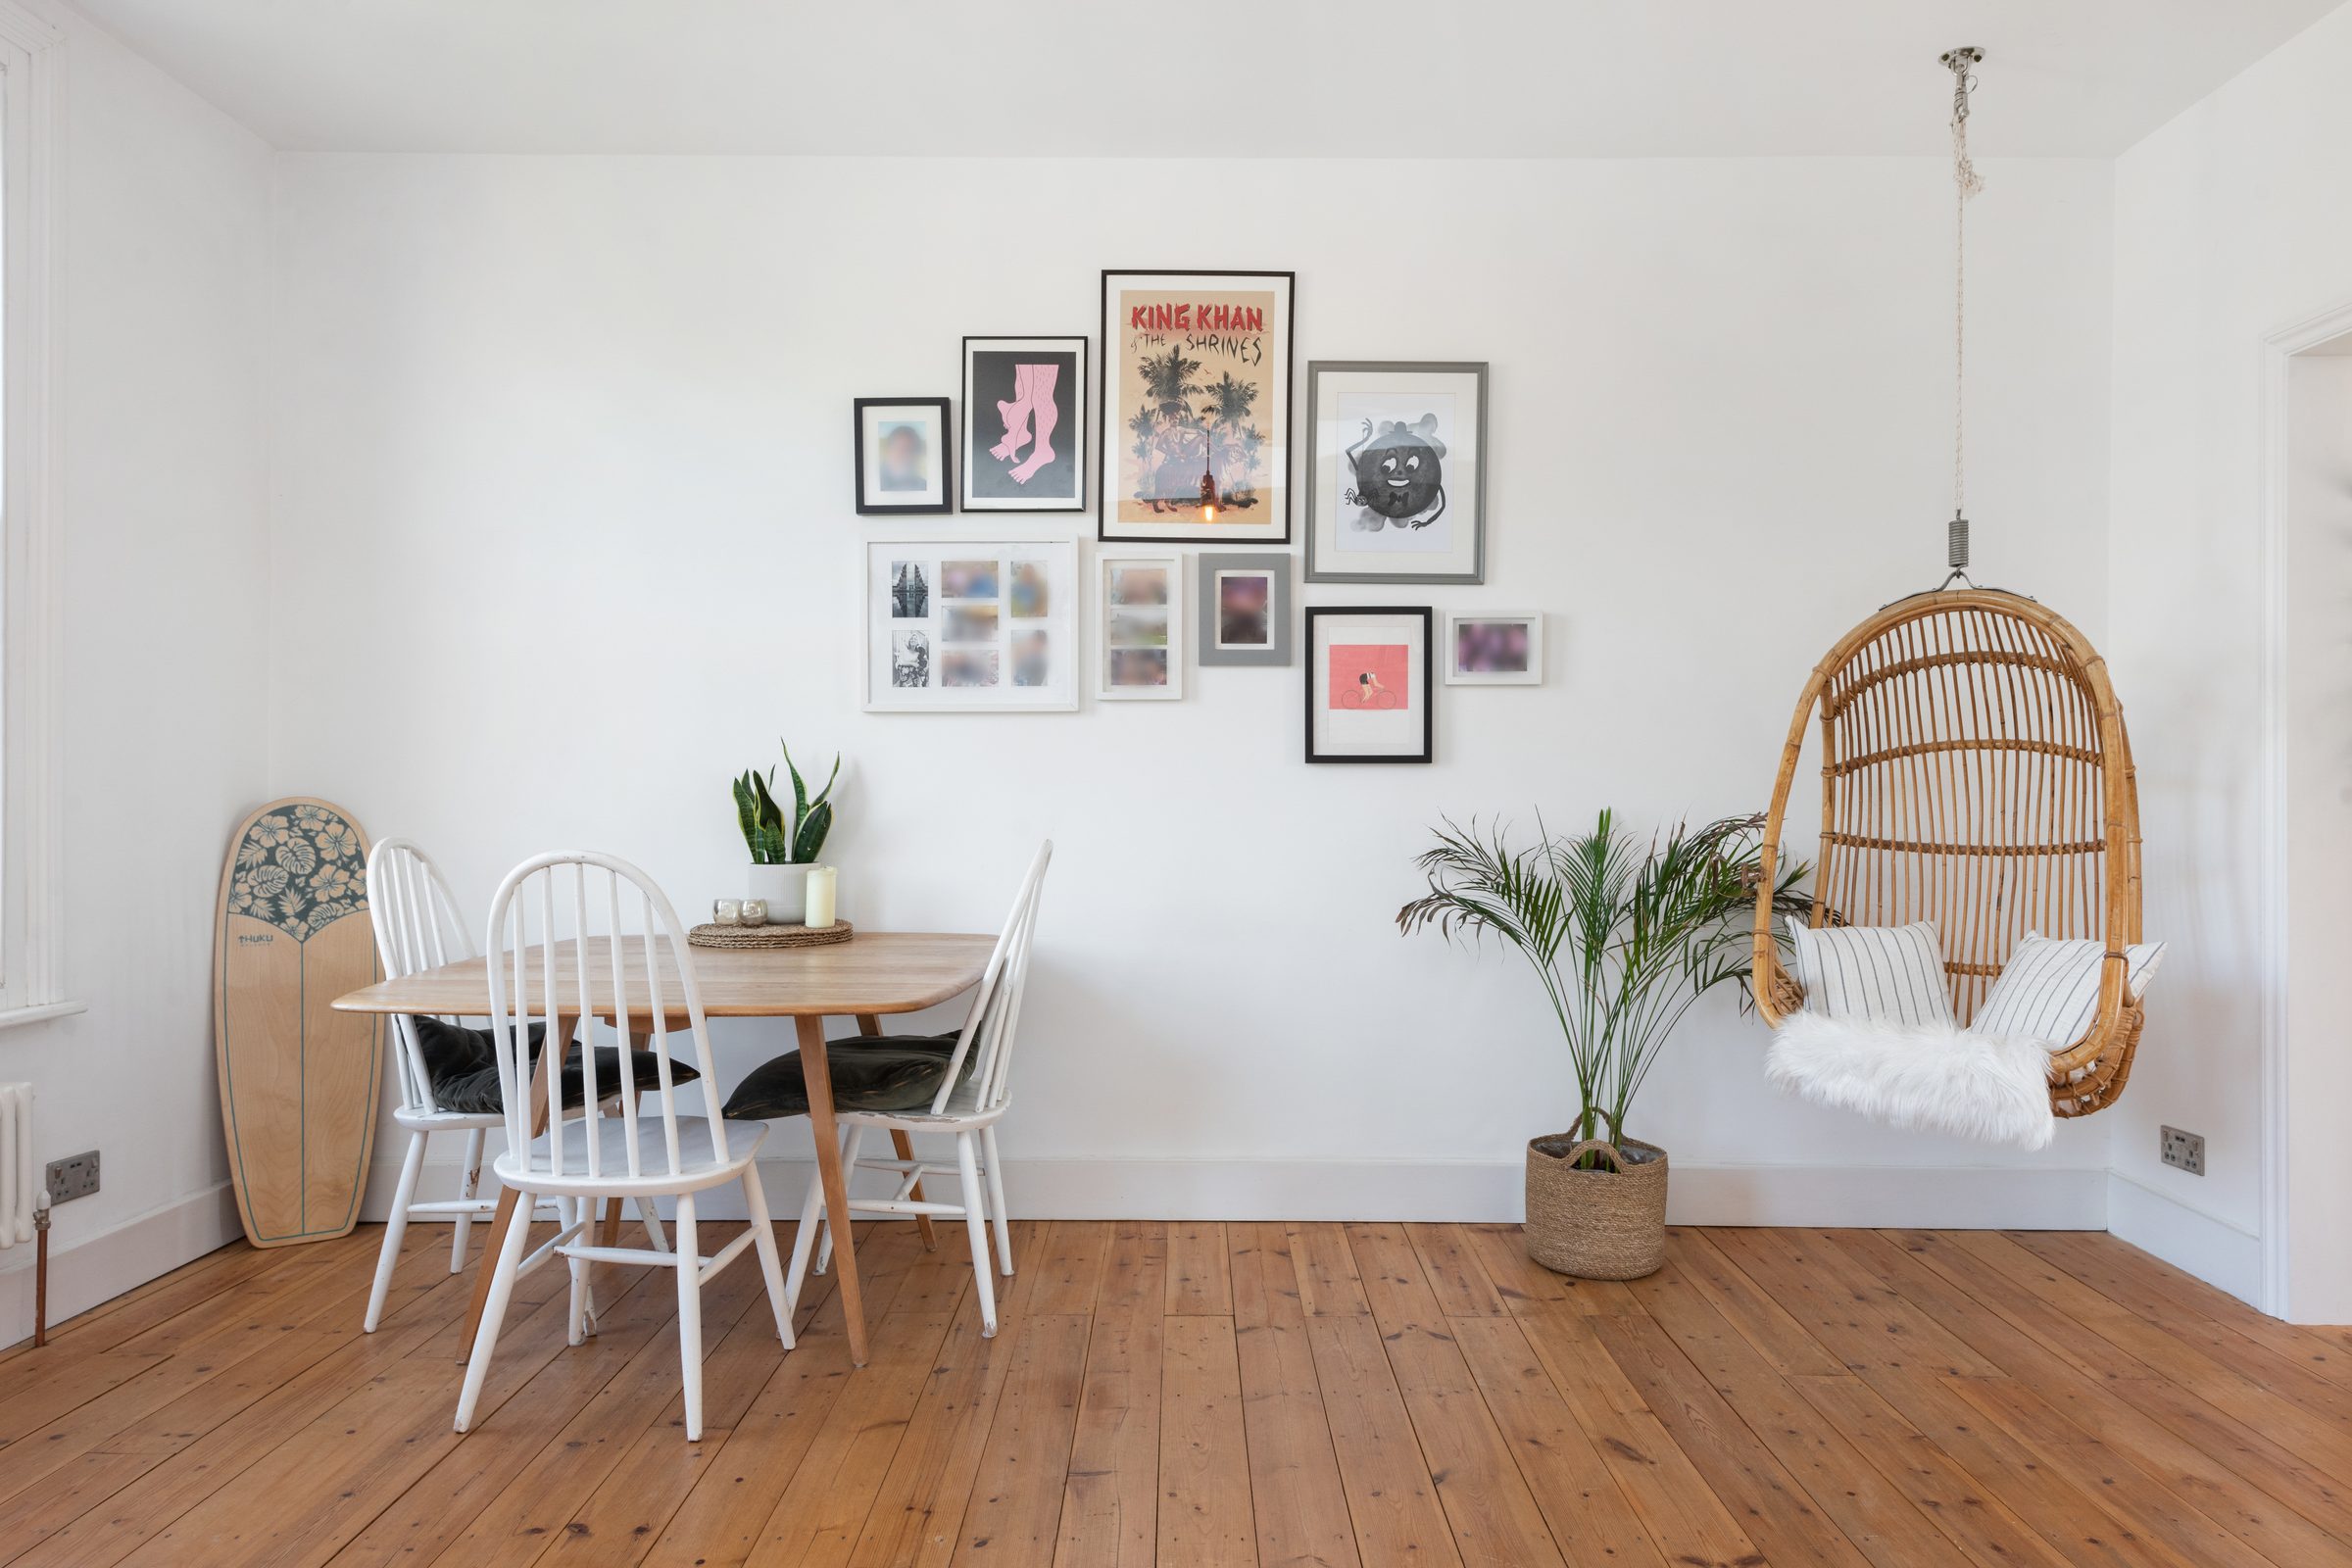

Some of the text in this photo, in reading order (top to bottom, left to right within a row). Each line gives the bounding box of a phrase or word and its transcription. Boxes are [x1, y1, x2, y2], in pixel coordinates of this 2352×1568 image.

[1131, 303, 1263, 332] KING KHAN
[1144, 333, 1166, 348] THE
[1185, 333, 1262, 368] SHRINES
